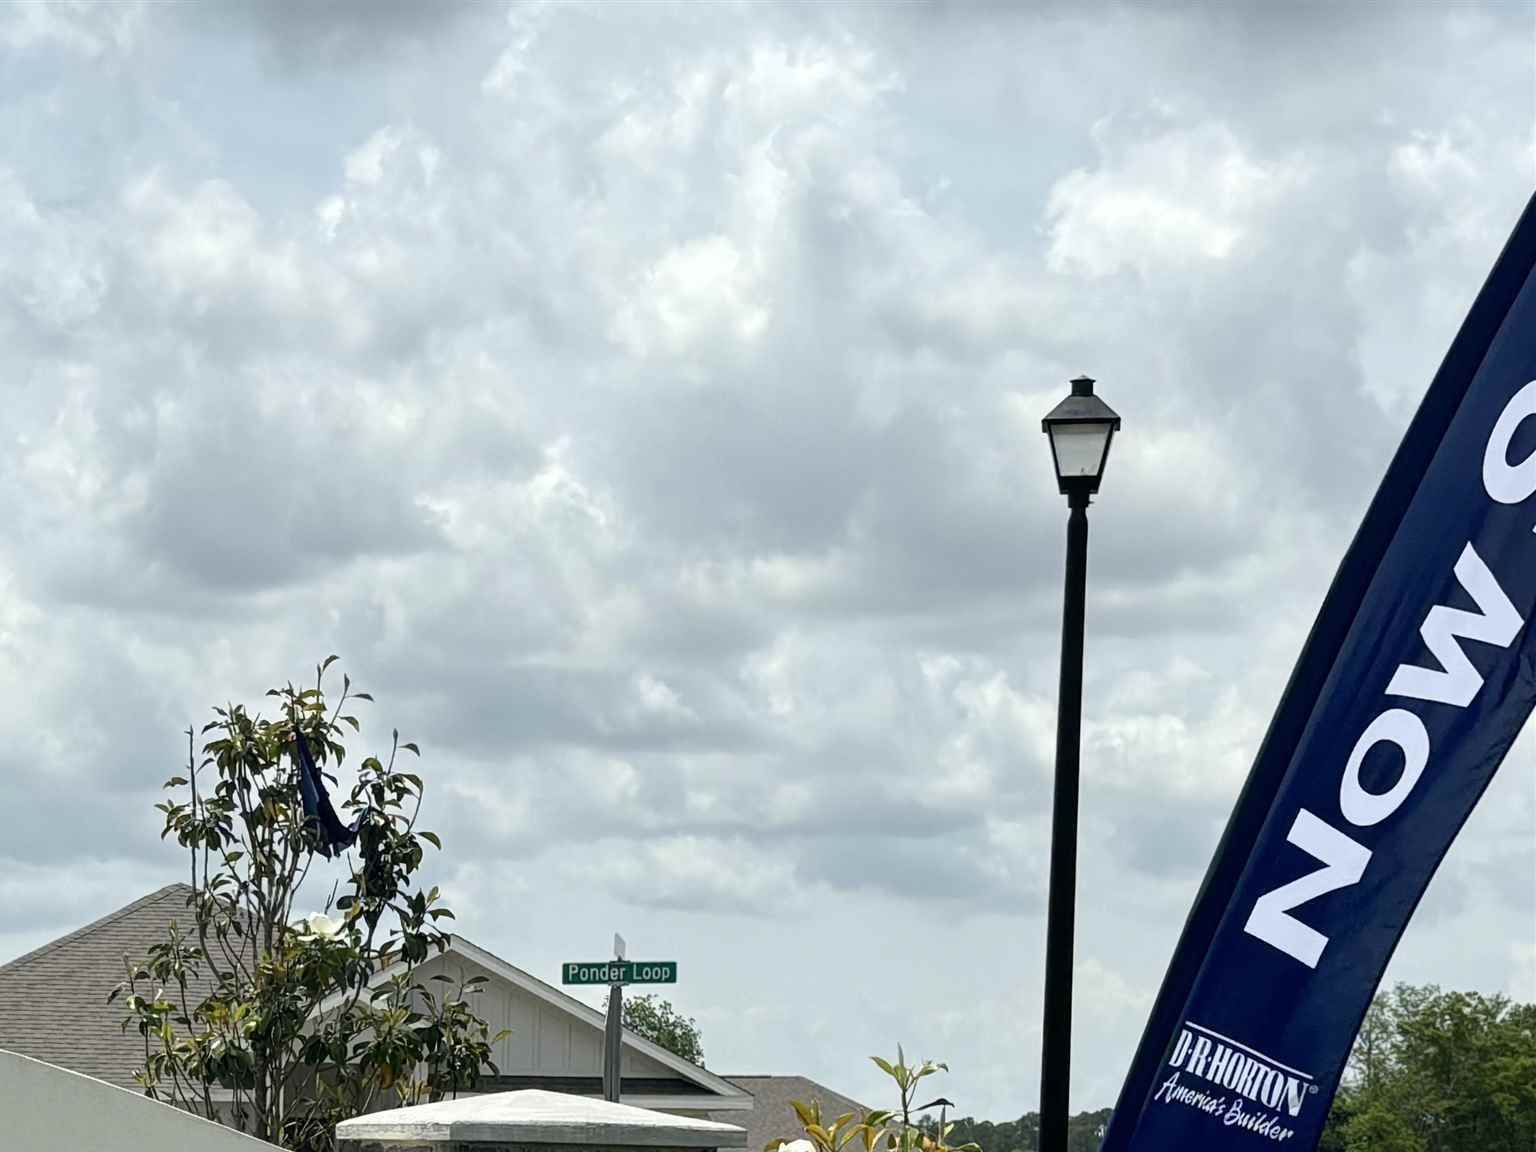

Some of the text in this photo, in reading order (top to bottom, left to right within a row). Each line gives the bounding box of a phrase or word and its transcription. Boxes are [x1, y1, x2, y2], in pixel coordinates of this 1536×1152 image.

[1243, 540, 1526, 970] NOW
[568, 963, 670, 982] Ponder Loop
[1154, 1071, 1294, 1141] America's Builder
